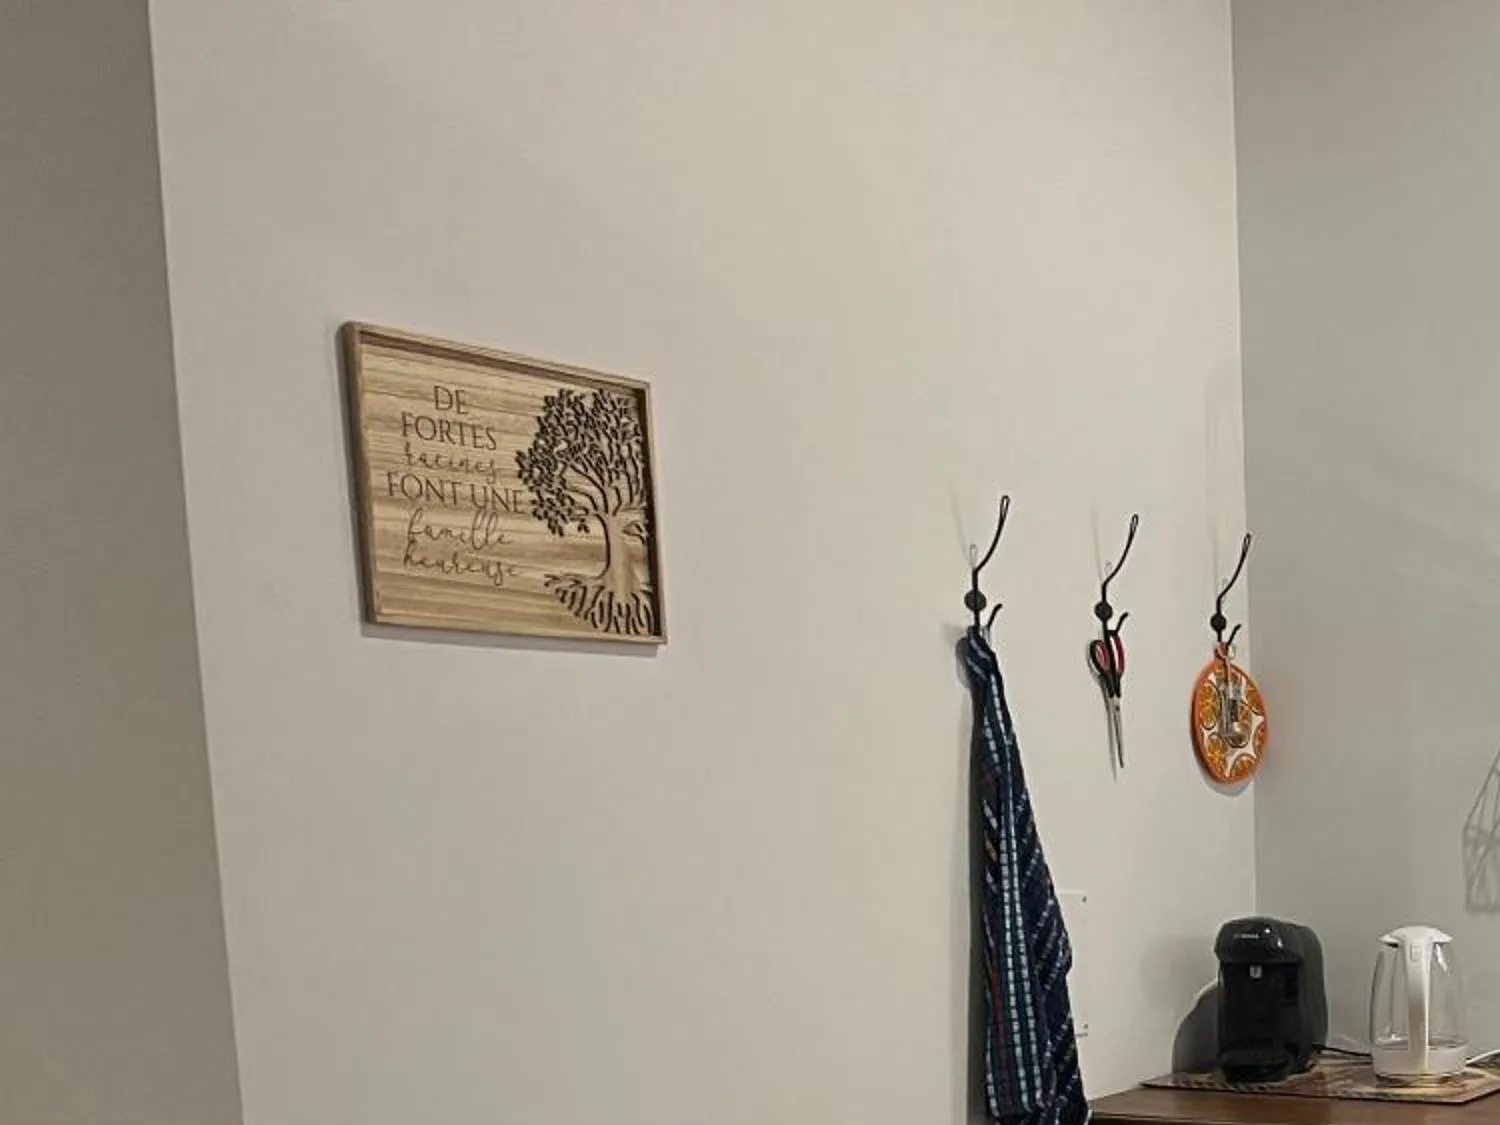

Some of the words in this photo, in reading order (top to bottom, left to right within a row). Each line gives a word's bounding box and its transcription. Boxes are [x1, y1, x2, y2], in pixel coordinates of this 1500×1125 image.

[433, 385, 469, 414] DE
[401, 411, 497, 451] FORTES
[387, 471, 461, 506] FONT
[469, 483, 527, 515] UNE
